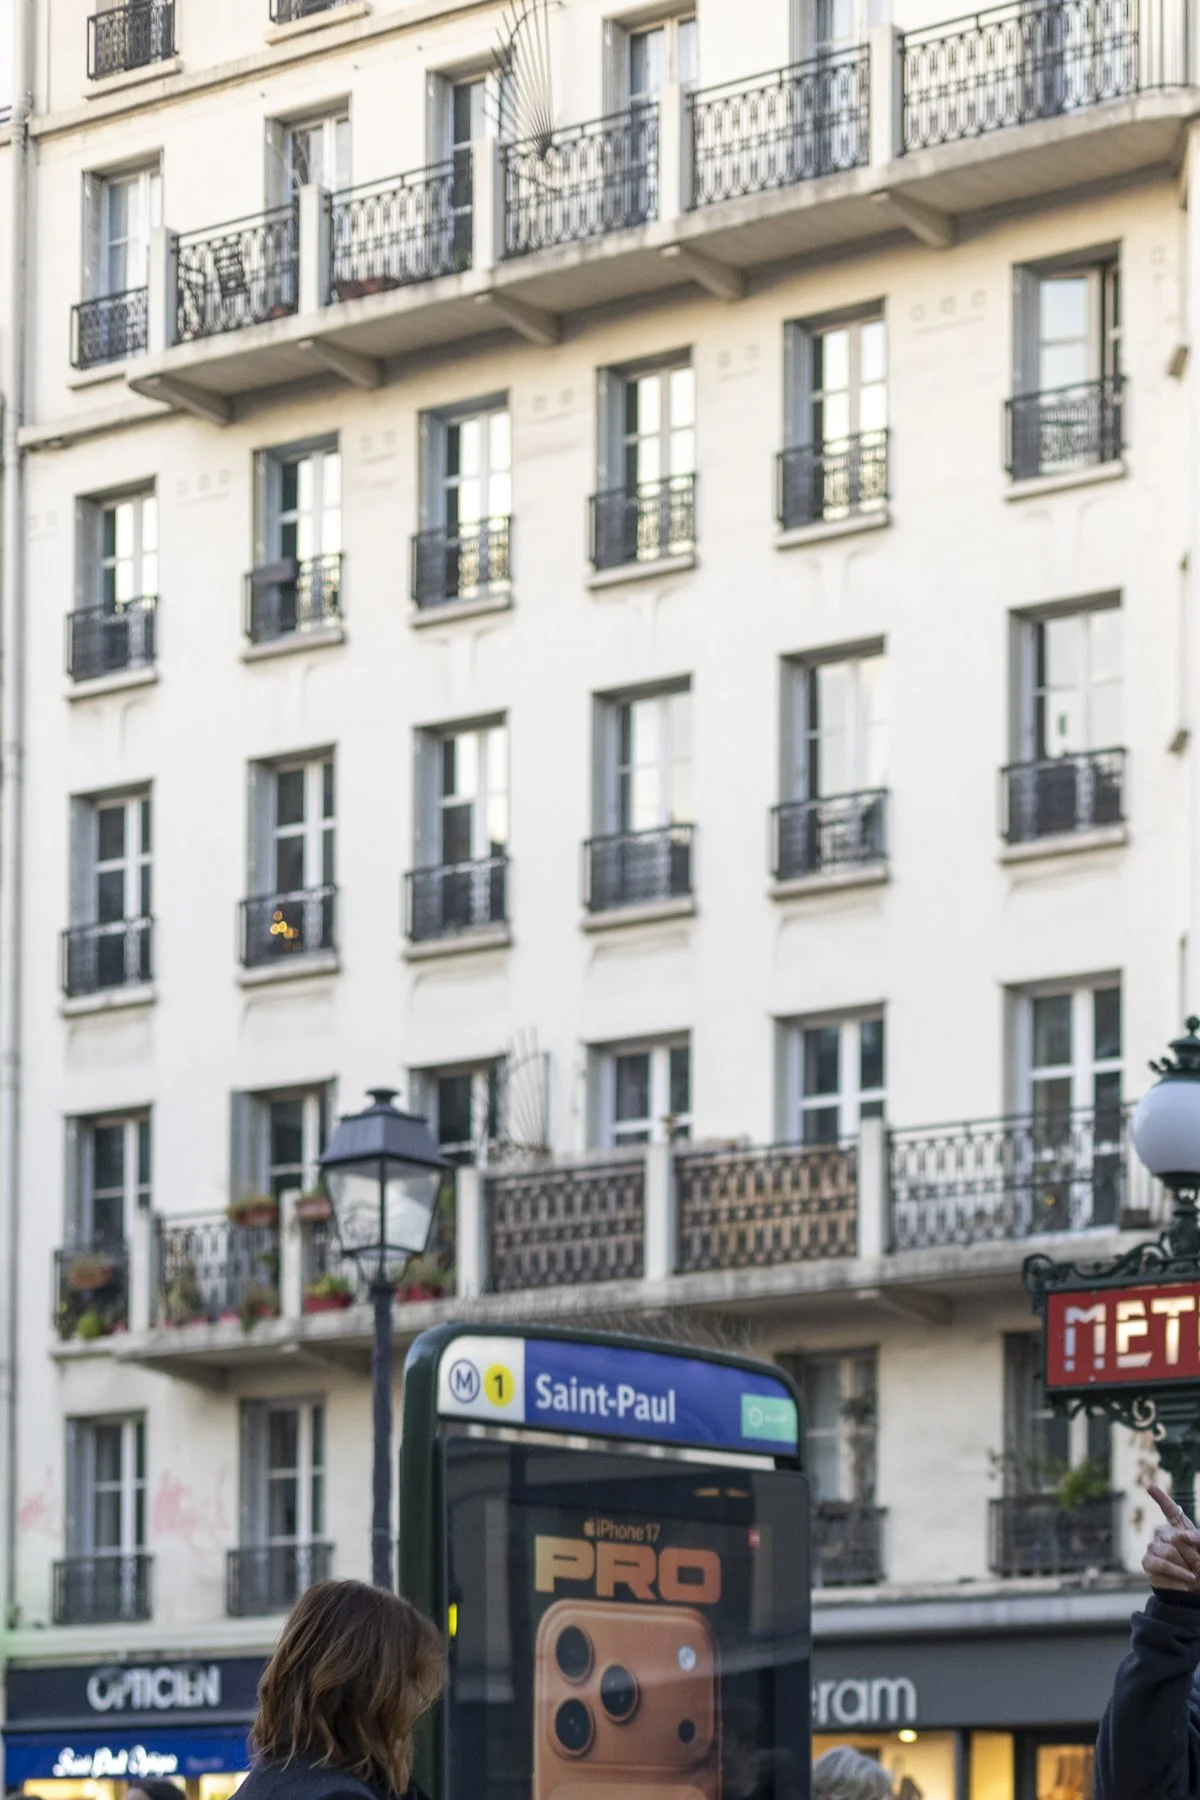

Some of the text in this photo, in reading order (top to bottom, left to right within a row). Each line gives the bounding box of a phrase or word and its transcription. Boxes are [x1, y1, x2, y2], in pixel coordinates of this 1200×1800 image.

[535, 1372, 676, 1425] Saint-Paul
[596, 1518, 661, 1543] iPhone 17
[535, 1534, 722, 1605] PRO
[86, 1664, 221, 1711] OPTICIEN
[811, 1677, 917, 1725] ram
